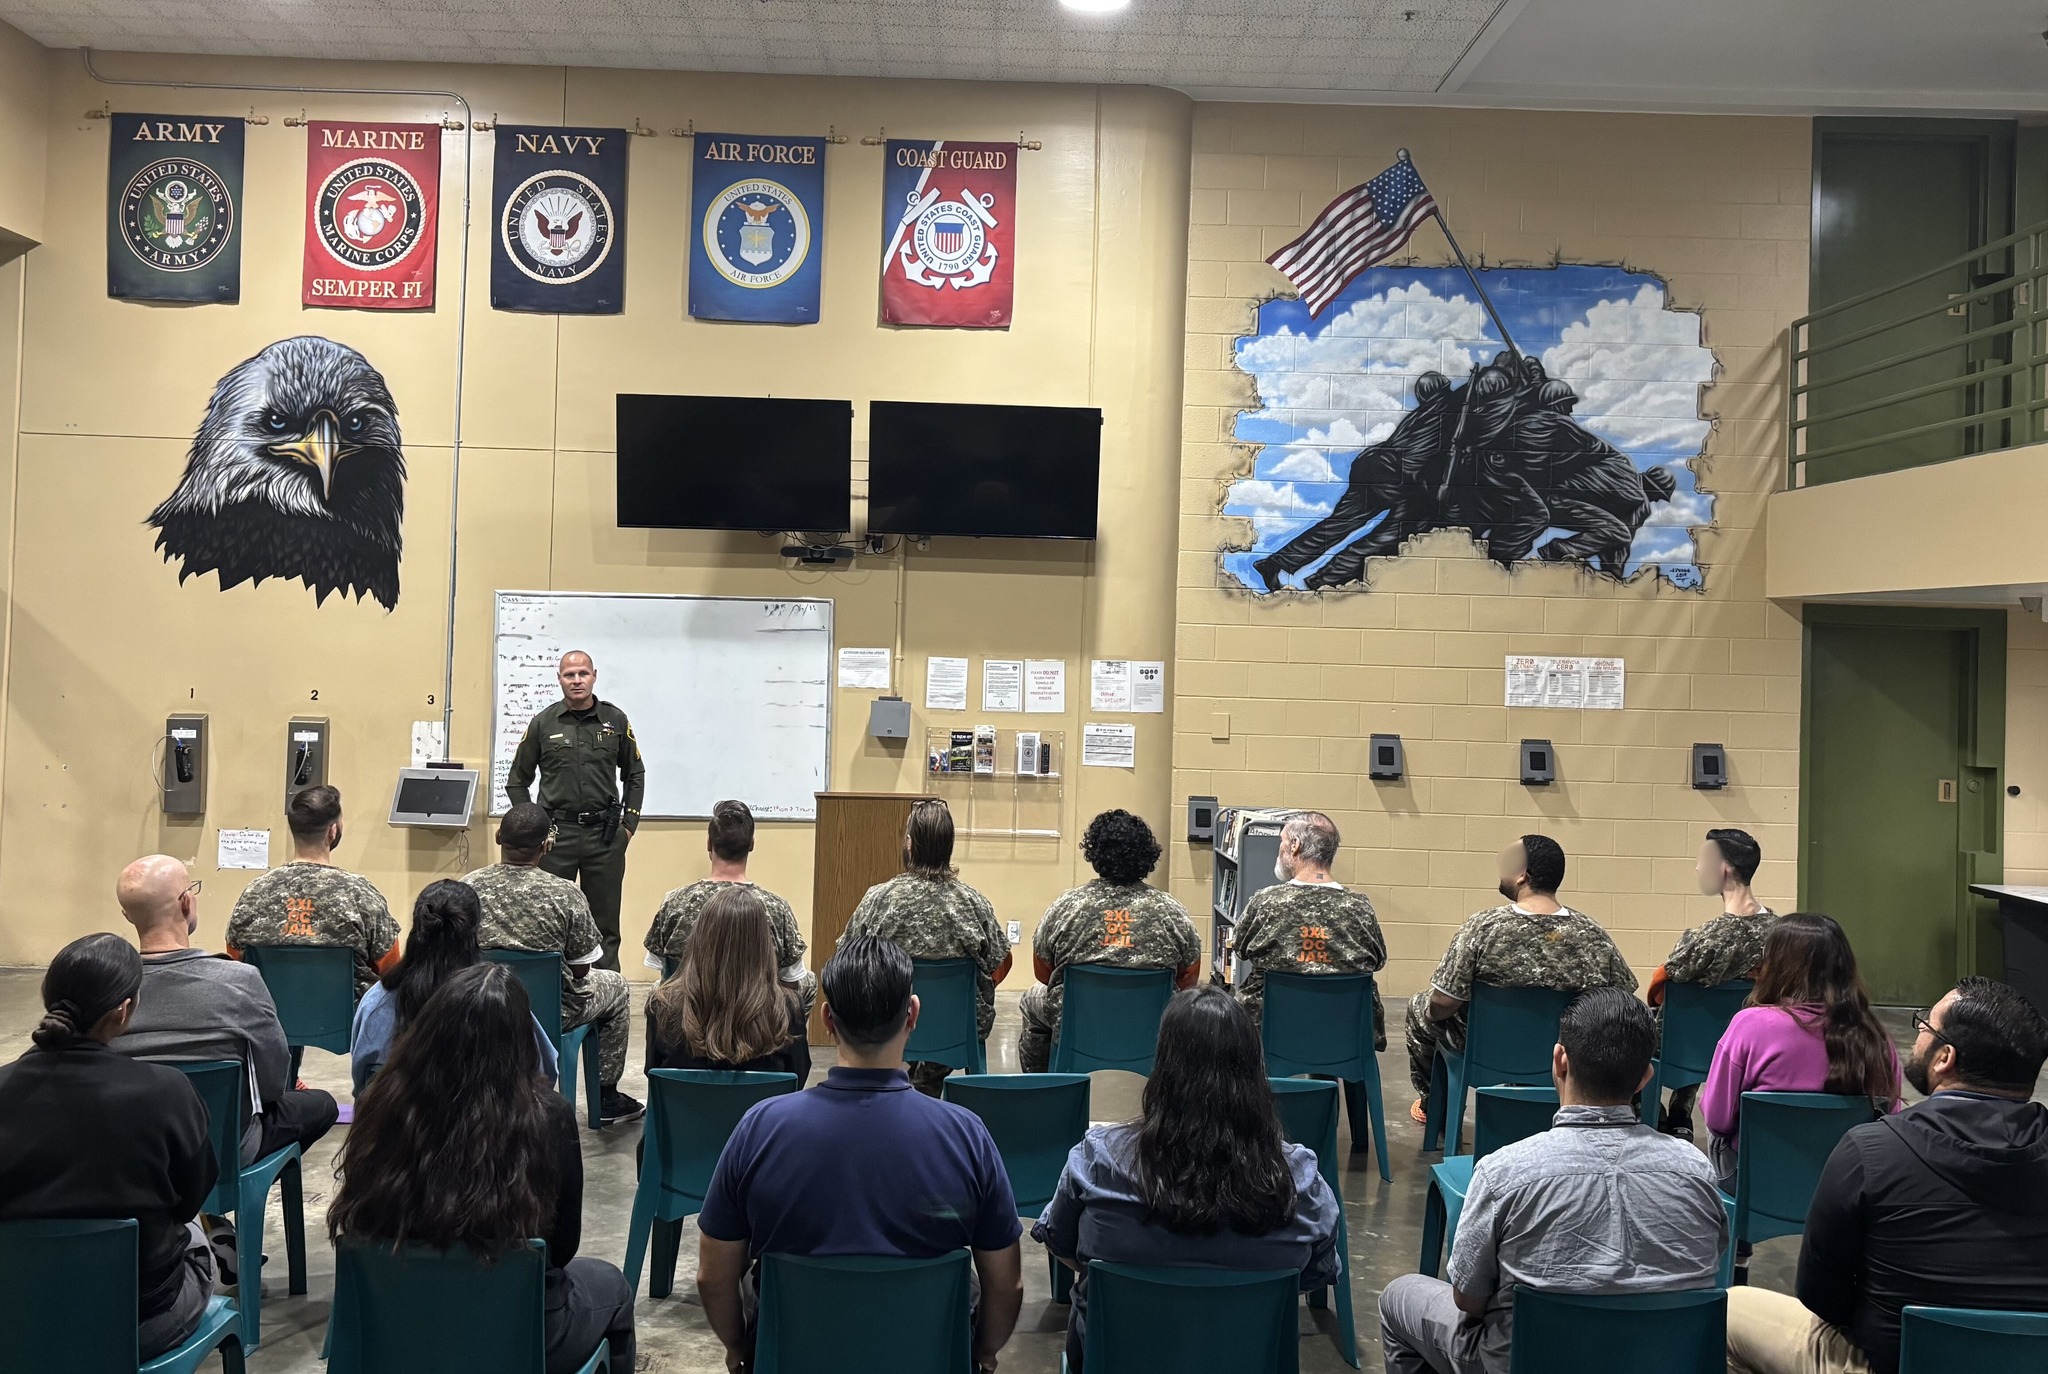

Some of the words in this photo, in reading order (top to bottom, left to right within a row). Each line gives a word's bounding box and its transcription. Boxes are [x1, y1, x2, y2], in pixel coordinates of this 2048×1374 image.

[132, 121, 225, 143] ARMY
[321, 128, 425, 150] MARINE
[515, 133, 606, 155] NAVY
[704, 141, 744, 161] AIR
[746, 143, 816, 165] FORCE
[896, 148, 949, 169] COAST
[950, 150, 1007, 170] GUARD
[130, 163, 178, 200] UNITED
[180, 164, 224, 203] STATES
[326, 165, 373, 199] UNITED
[375, 166, 416, 203] STATES
[723, 183, 760, 203] UNITED
[761, 184, 793, 205] STATES
[508, 180, 546, 240] UNITED
[575, 183, 608, 244] STATES
[921, 204, 953, 227] STATES
[955, 206, 981, 231] COAST
[323, 223, 370, 263] MARINE
[374, 226, 415, 263] CORPS
[917, 228, 934, 265] UNITED
[961, 235, 981, 265] GUARD
[149, 250, 200, 266] ARMY
[938, 262, 960, 271] 1790
[535, 263, 577, 277] NAVY
[730, 269, 747, 282] AIR
[749, 270, 782, 283] FORCE
[311, 278, 399, 299] SEMPER
[401, 281, 423, 299] FI
[190, 687, 195, 699] 1
[310, 689, 319, 701] 2
[427, 694, 435, 705] 3
[287, 911, 311, 924] OC
[1103, 909, 1135, 923] 2XL
[281, 923, 318, 936] JAIL
[1107, 923, 1130, 935] OC
[1299, 925, 1331, 940] 3XL
[1302, 939, 1327, 951] OC
[1296, 951, 1333, 964] JAIL
